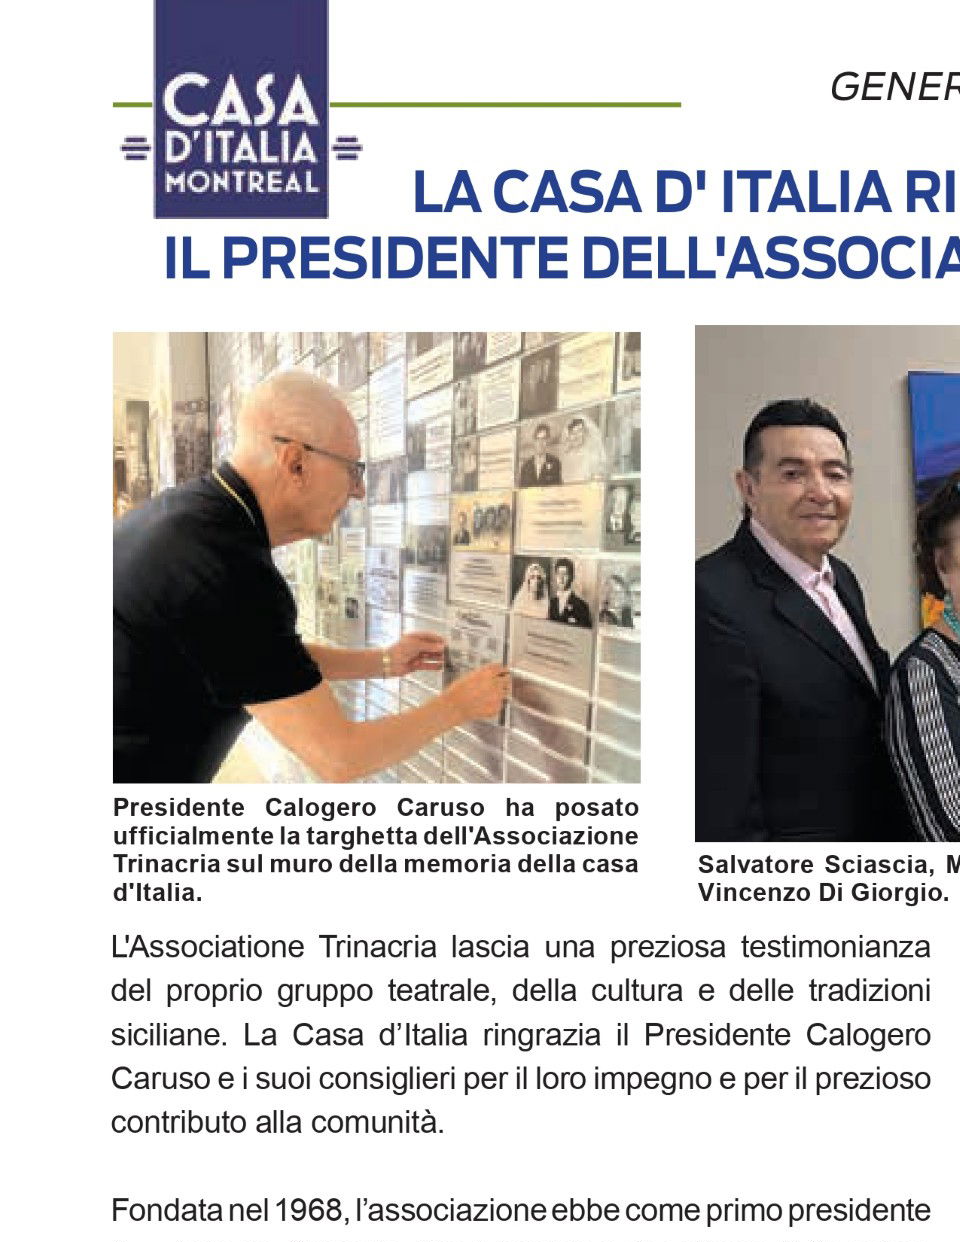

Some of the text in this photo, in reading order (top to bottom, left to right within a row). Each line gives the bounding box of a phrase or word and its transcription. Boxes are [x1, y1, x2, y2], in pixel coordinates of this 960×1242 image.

[163, 71, 320, 127] CASA
[164, 169, 320, 193] MONTREAL
[414, 169, 483, 213] LA
[493, 168, 643, 214] CASA
[656, 169, 706, 213] D'
[723, 169, 893, 213] ITALIA
[166, 235, 211, 280] IL
[223, 235, 569, 280] PRESIDENTE
[113, 797, 639, 822] Presidente Calogero Caruso ha posato
[113, 825, 639, 851] ufficialmente la targhetta dell'Associazione
[112, 853, 639, 873] Trinacria sul muro della memoria della casa
[698, 854, 814, 874] Salvatore
[824, 854, 935, 878] Sciascia,
[113, 882, 202, 902] d'Italia.
[697, 882, 949, 907] Vincenzo Di Giorgio.
[112, 934, 931, 964] L'Associatione Trinacria lascia una preziosa testimonianza
[110, 977, 931, 1008] del proprio gruppo teatrale, della cultura e delle tradizioni
[112, 1197, 931, 1228] Fondata nel 1968, l’associazione ebbe come primo presidente
